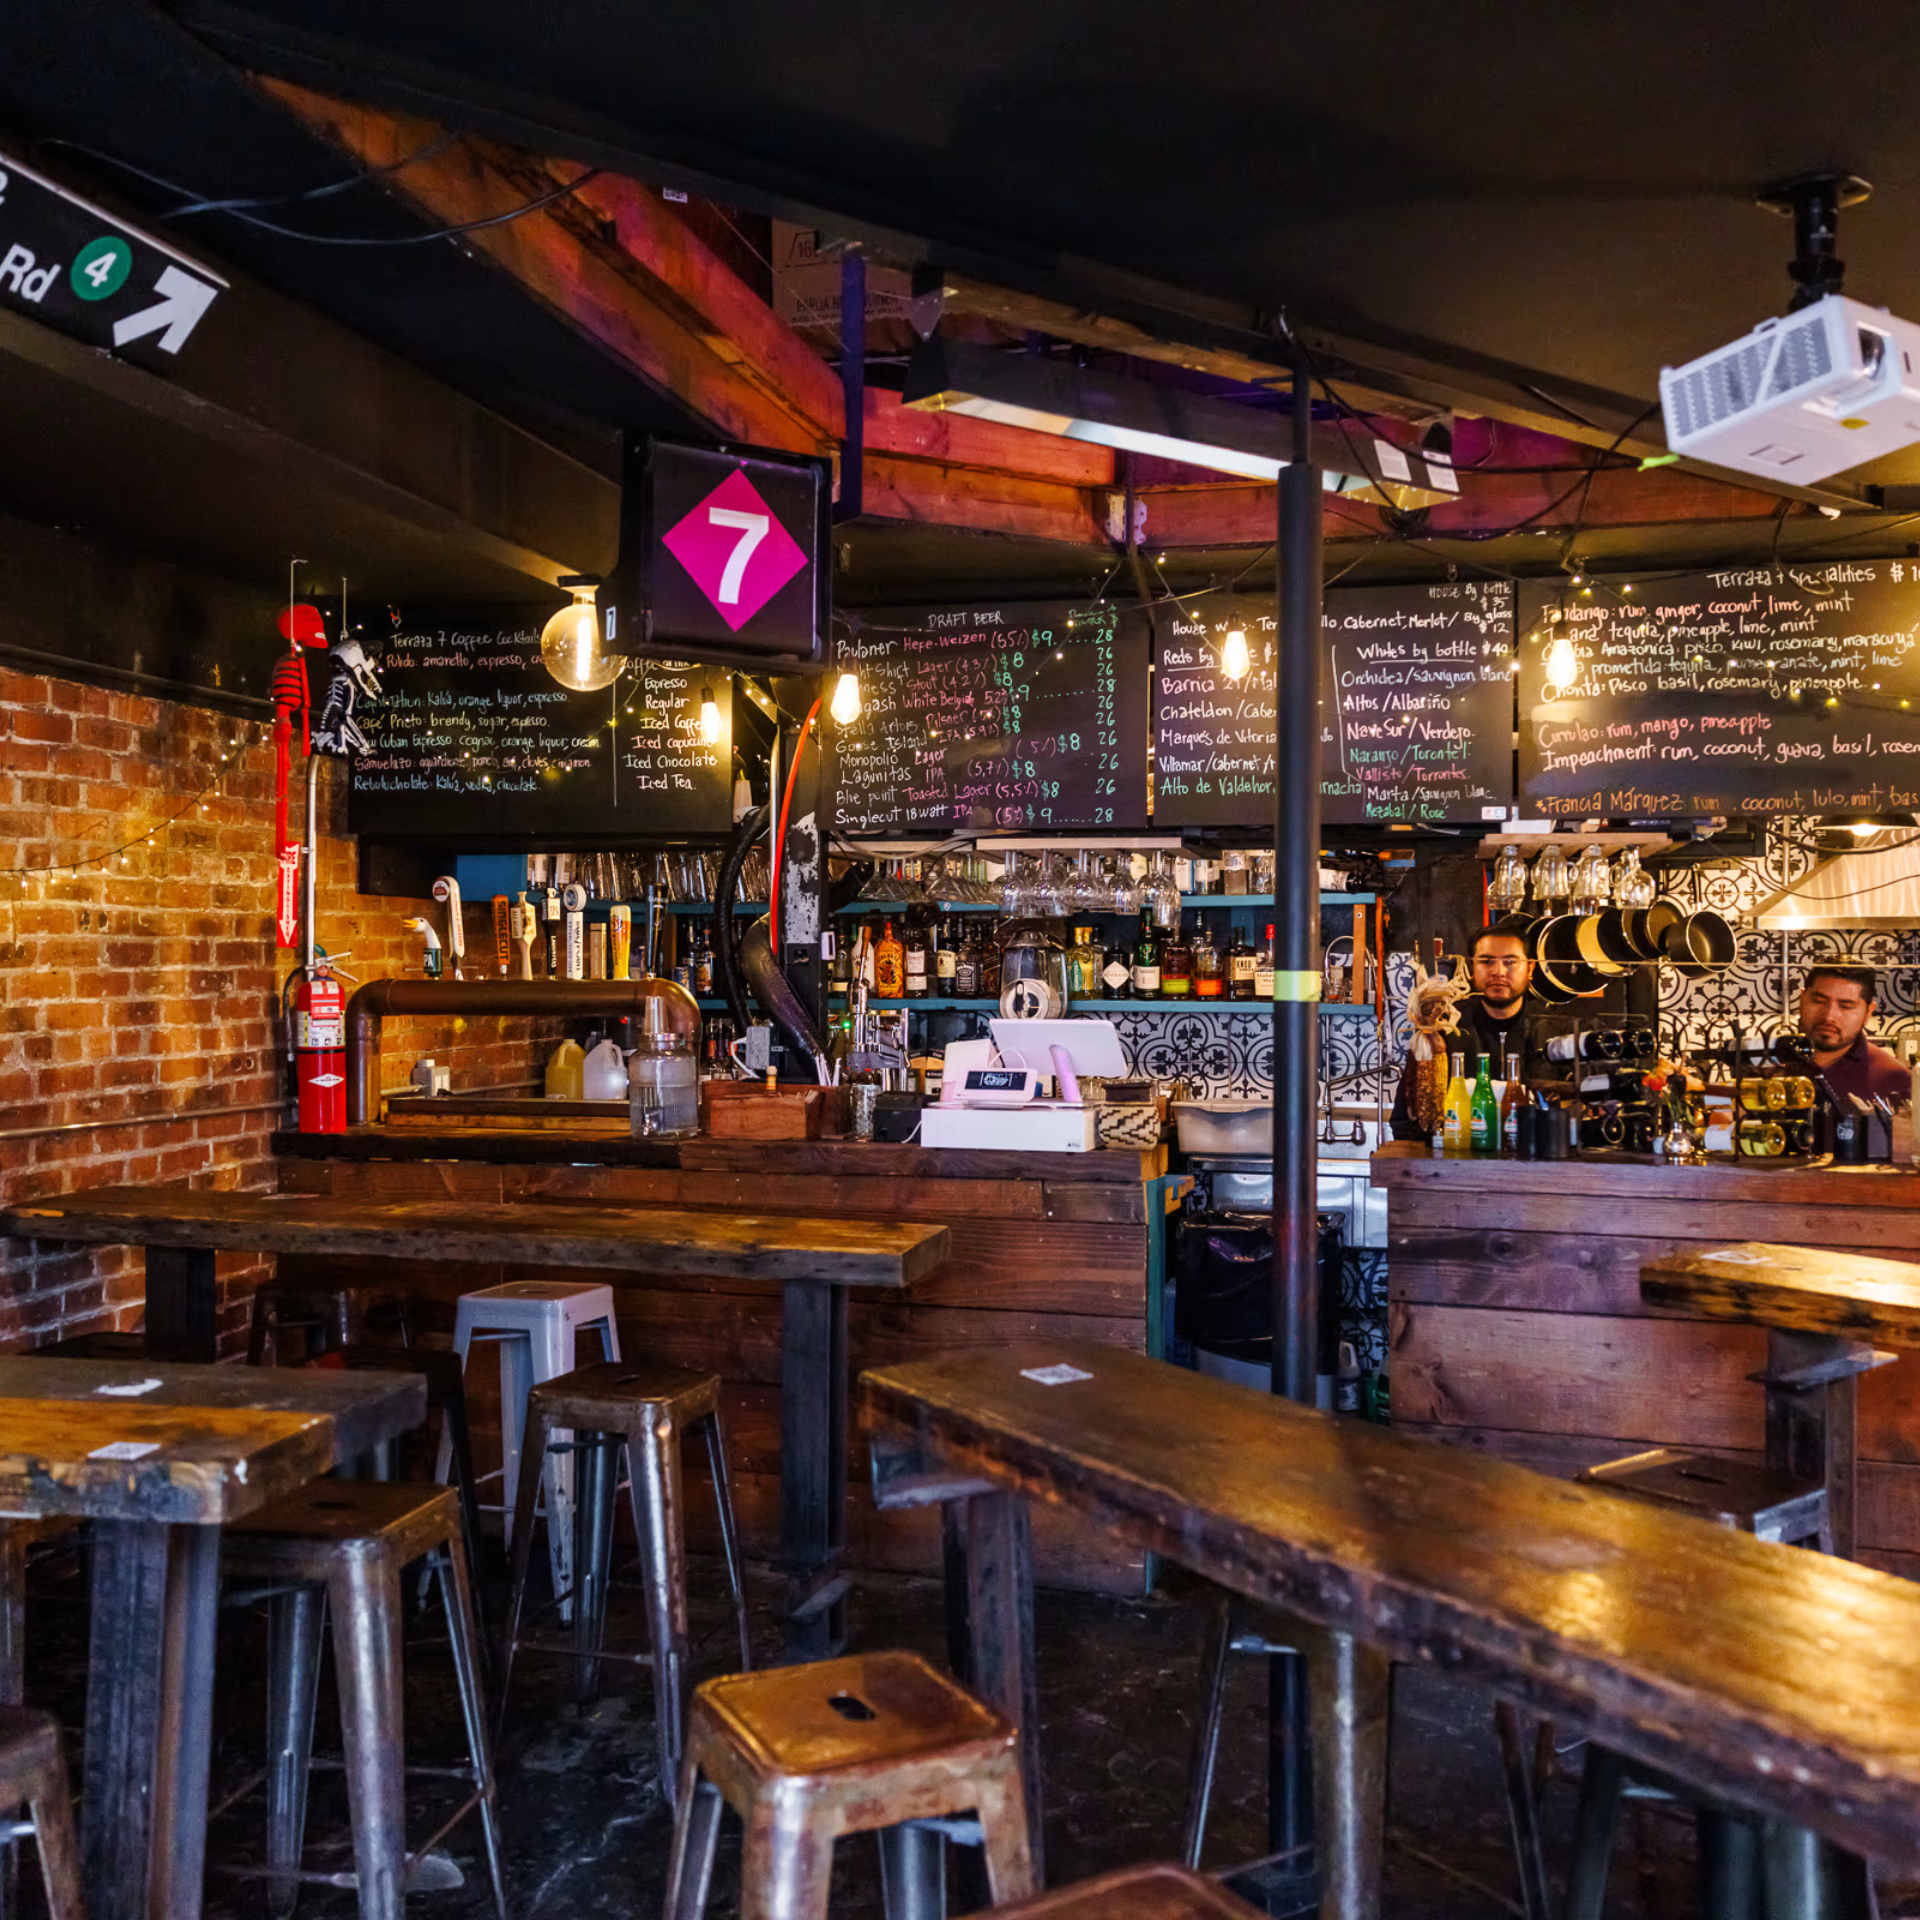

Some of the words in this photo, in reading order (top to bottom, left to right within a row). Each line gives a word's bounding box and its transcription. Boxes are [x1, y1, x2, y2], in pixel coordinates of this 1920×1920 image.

[0, 243, 61, 303] Rd
[84, 252, 118, 287] 4
[709, 507, 770, 605] 7
[1815, 589, 1854, 612] mint
[927, 611, 968, 629] DRAFT
[973, 610, 1005, 626] BEER
[1780, 614, 1819, 632] mint
[836, 638, 899, 660] Paulaner
[1095, 628, 1114, 644] 28
[1096, 646, 1114, 661] 26
[1412, 642, 1429, 664] by
[1435, 640, 1477, 657] bottle
[1163, 647, 1193, 666] Reds
[1199, 647, 1214, 668] by
[644, 677, 688, 694] Espresso
[906, 674, 939, 691] Stout
[1096, 662, 1114, 677] 26
[1096, 678, 1116, 692] 28
[645, 691, 691, 717] Regular
[1097, 694, 1114, 710] 26
[640, 713, 670, 730] Iced
[1095, 711, 1116, 727] 26
[630, 733, 662, 750] Iced
[1097, 730, 1117, 746] 26
[1216, 728, 1232, 745] de
[622, 752, 652, 769] Iced
[657, 749, 718, 769] Chocolate
[841, 765, 912, 789] Lagunitas
[926, 766, 946, 783] IPA
[1098, 753, 1120, 770] 26
[636, 773, 669, 790] Iced
[1095, 778, 1116, 795] 26
[1160, 775, 1189, 796] Alto
[1196, 776, 1212, 794] de
[835, 805, 902, 830] Singlecut
[953, 803, 974, 819] IPA
[1095, 807, 1114, 824] 28
